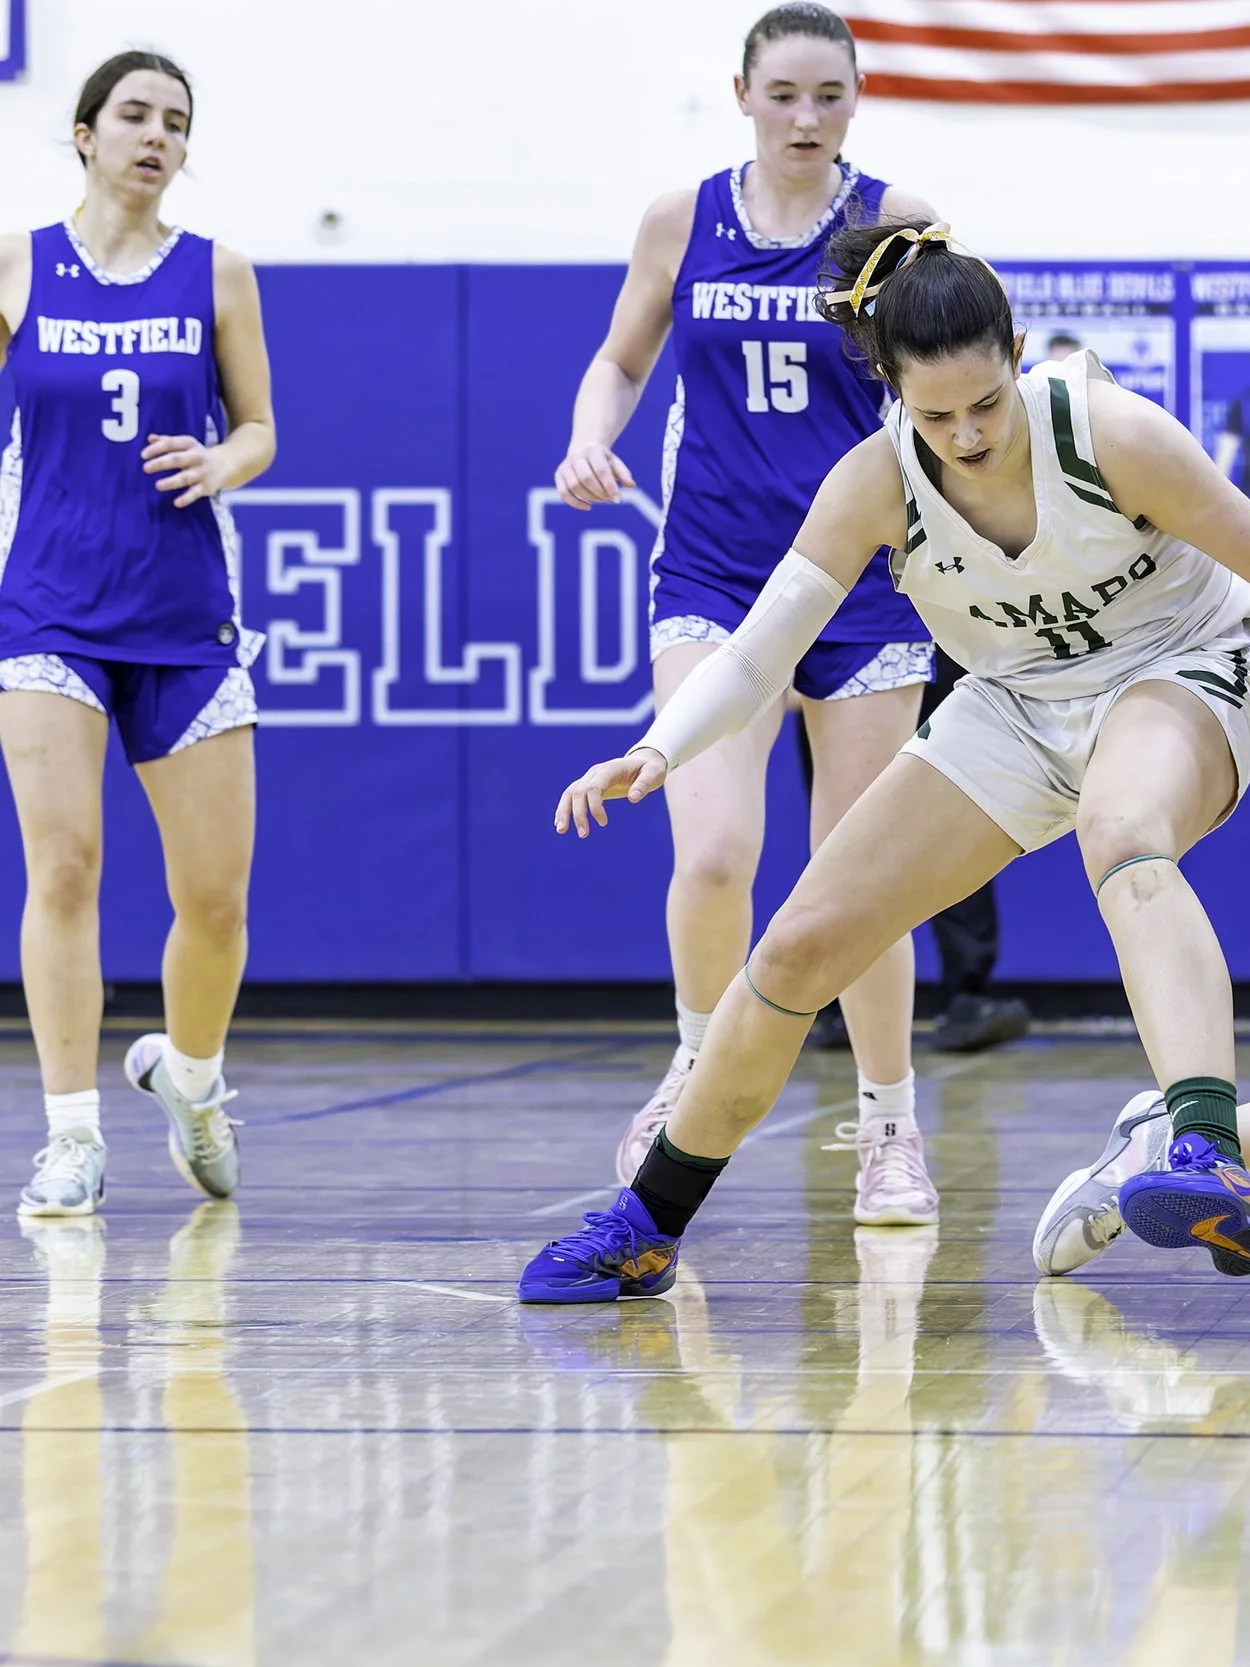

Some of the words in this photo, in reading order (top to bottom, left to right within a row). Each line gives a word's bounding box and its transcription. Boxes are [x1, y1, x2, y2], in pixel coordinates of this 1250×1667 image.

[692, 282, 834, 322] WESTFIE
[37, 315, 203, 355] WESTFIELD
[741, 340, 809, 414] 15
[101, 368, 140, 442] 3
[1034, 620, 1113, 660] 11
